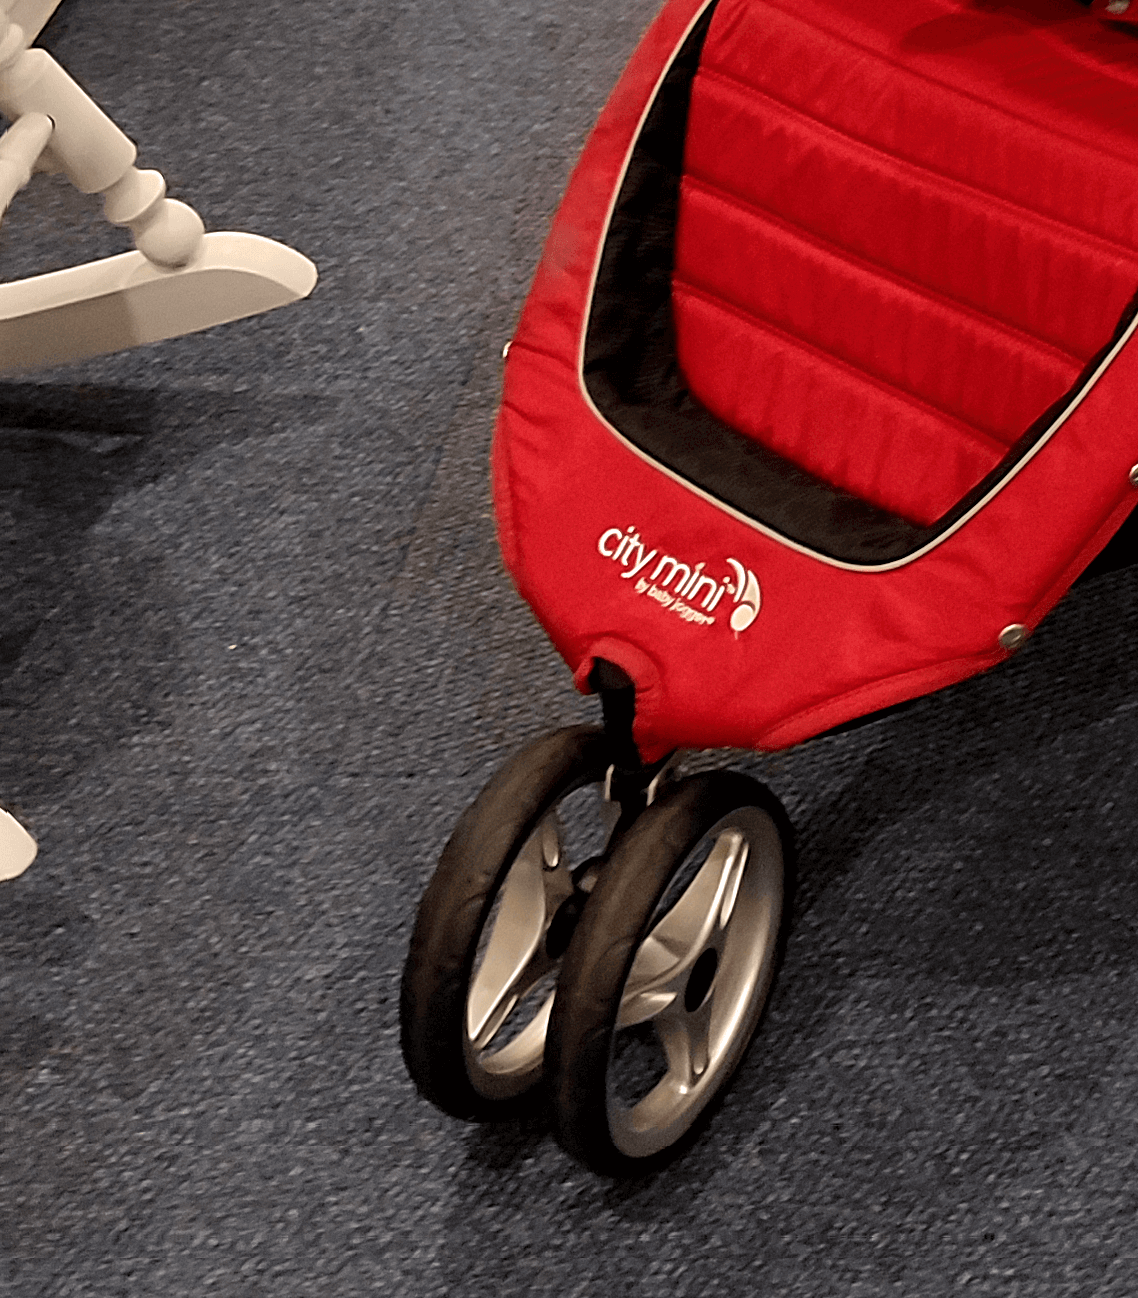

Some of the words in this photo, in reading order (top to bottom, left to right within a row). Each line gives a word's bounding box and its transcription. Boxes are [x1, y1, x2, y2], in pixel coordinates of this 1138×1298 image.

[597, 525, 659, 579] city
[649, 554, 731, 612] mini
[634, 576, 651, 595] by
[647, 583, 676, 608] baby
